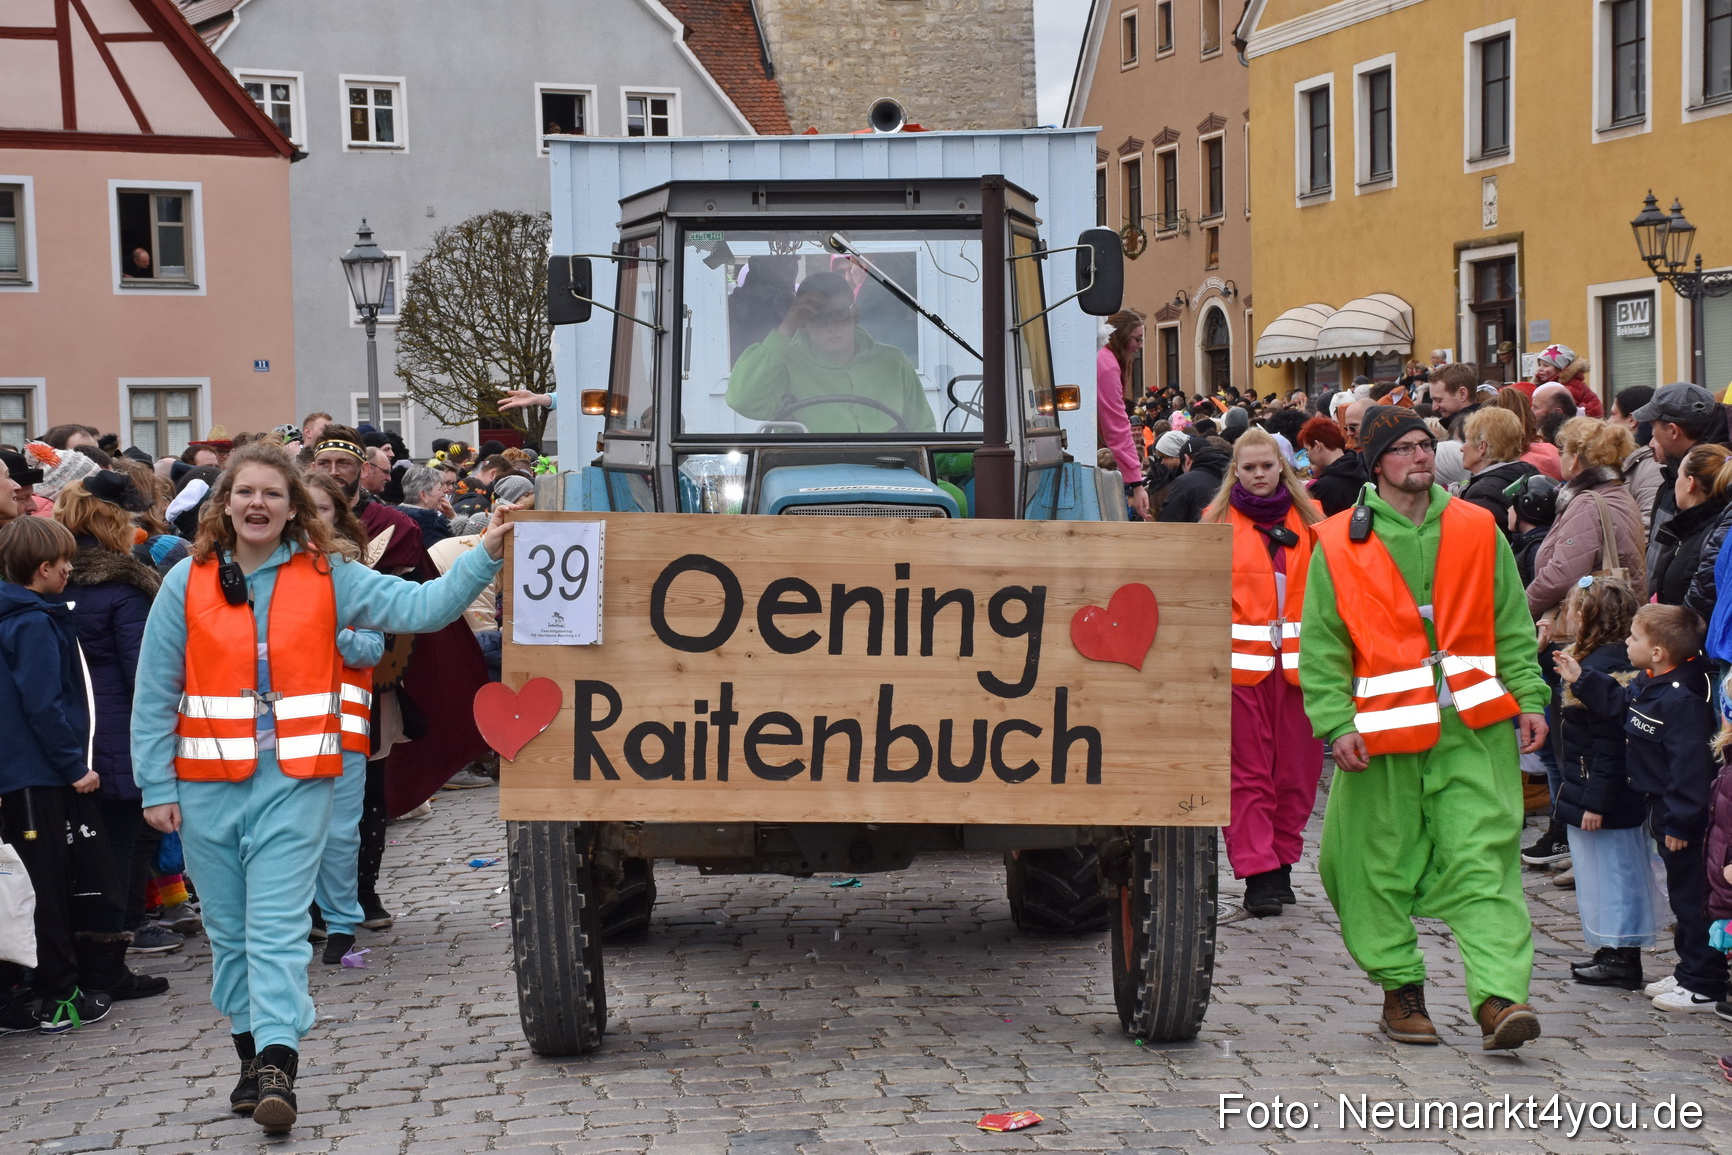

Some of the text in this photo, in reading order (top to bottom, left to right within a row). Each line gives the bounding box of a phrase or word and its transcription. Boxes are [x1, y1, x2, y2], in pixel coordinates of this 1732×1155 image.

[1618, 301, 1648, 323] BW
[1616, 324, 1650, 337] Bekleidung
[258, 360, 266, 368] 11
[523, 544, 589, 601] 39
[650, 553, 1047, 699] Oening
[573, 679, 1103, 784] Raitenbuch
[1630, 715, 1656, 735] POLICE
